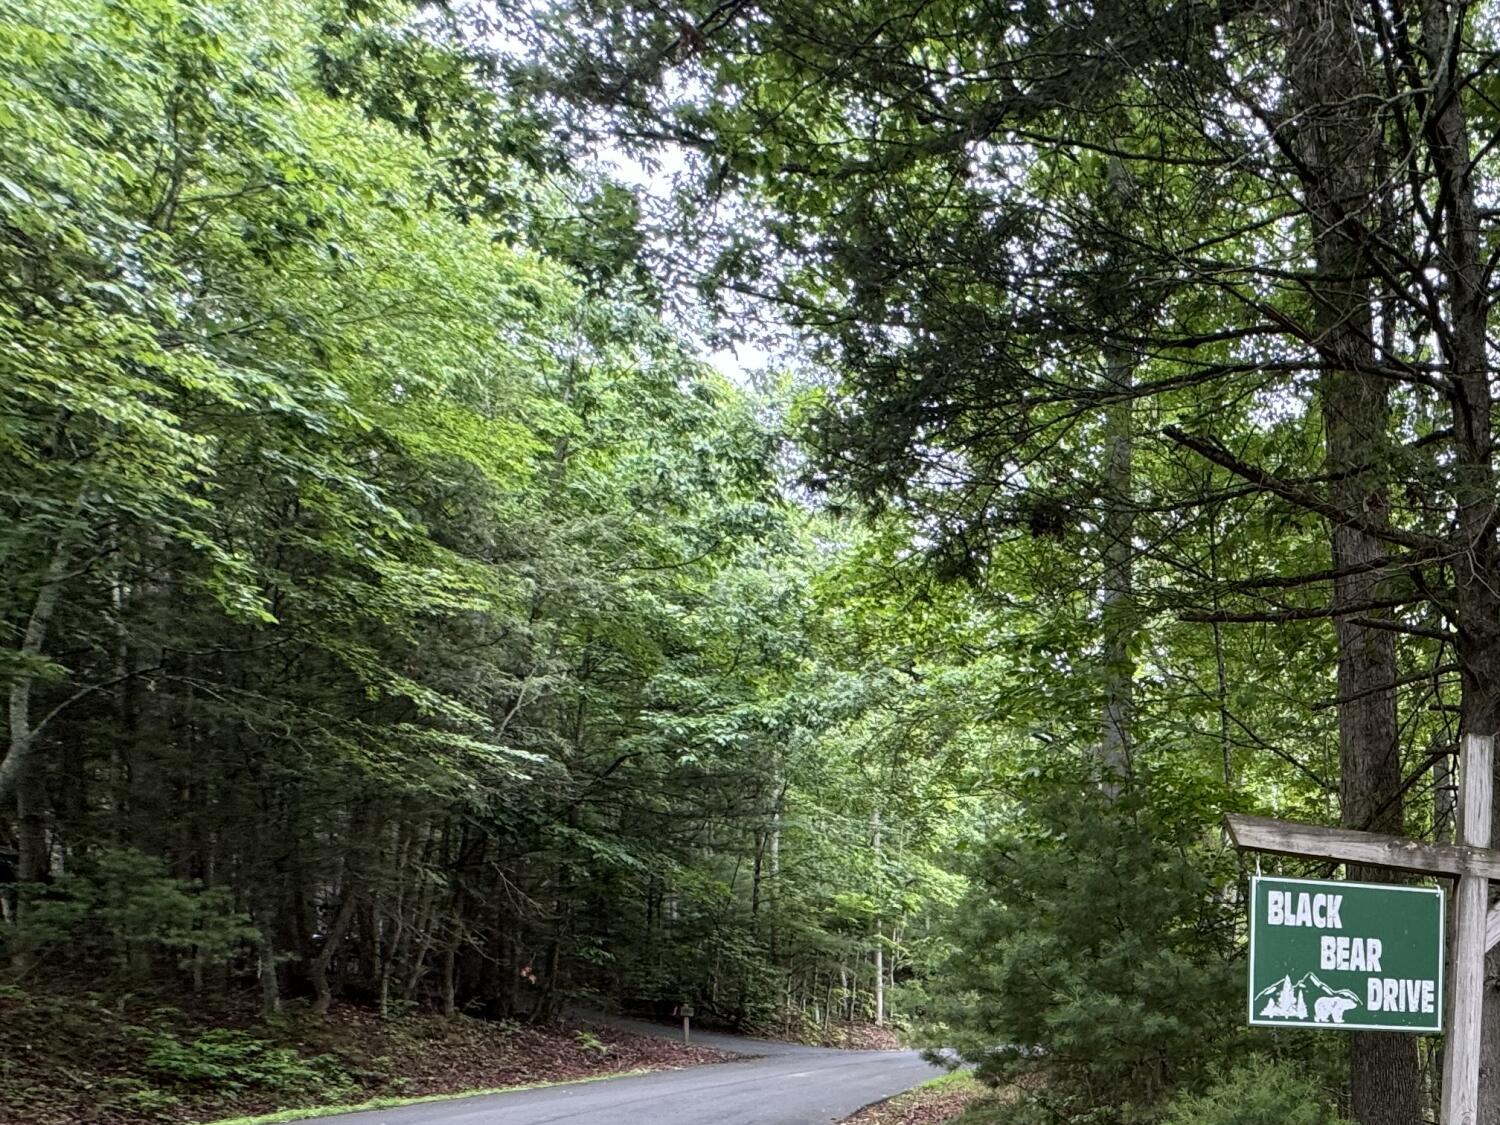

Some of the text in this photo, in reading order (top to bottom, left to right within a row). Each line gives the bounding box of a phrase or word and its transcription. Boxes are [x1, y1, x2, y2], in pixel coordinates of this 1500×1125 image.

[1267, 890, 1343, 929] BLACK
[1320, 935, 1382, 972] BEAR
[1367, 977, 1434, 1014] DRIVE
